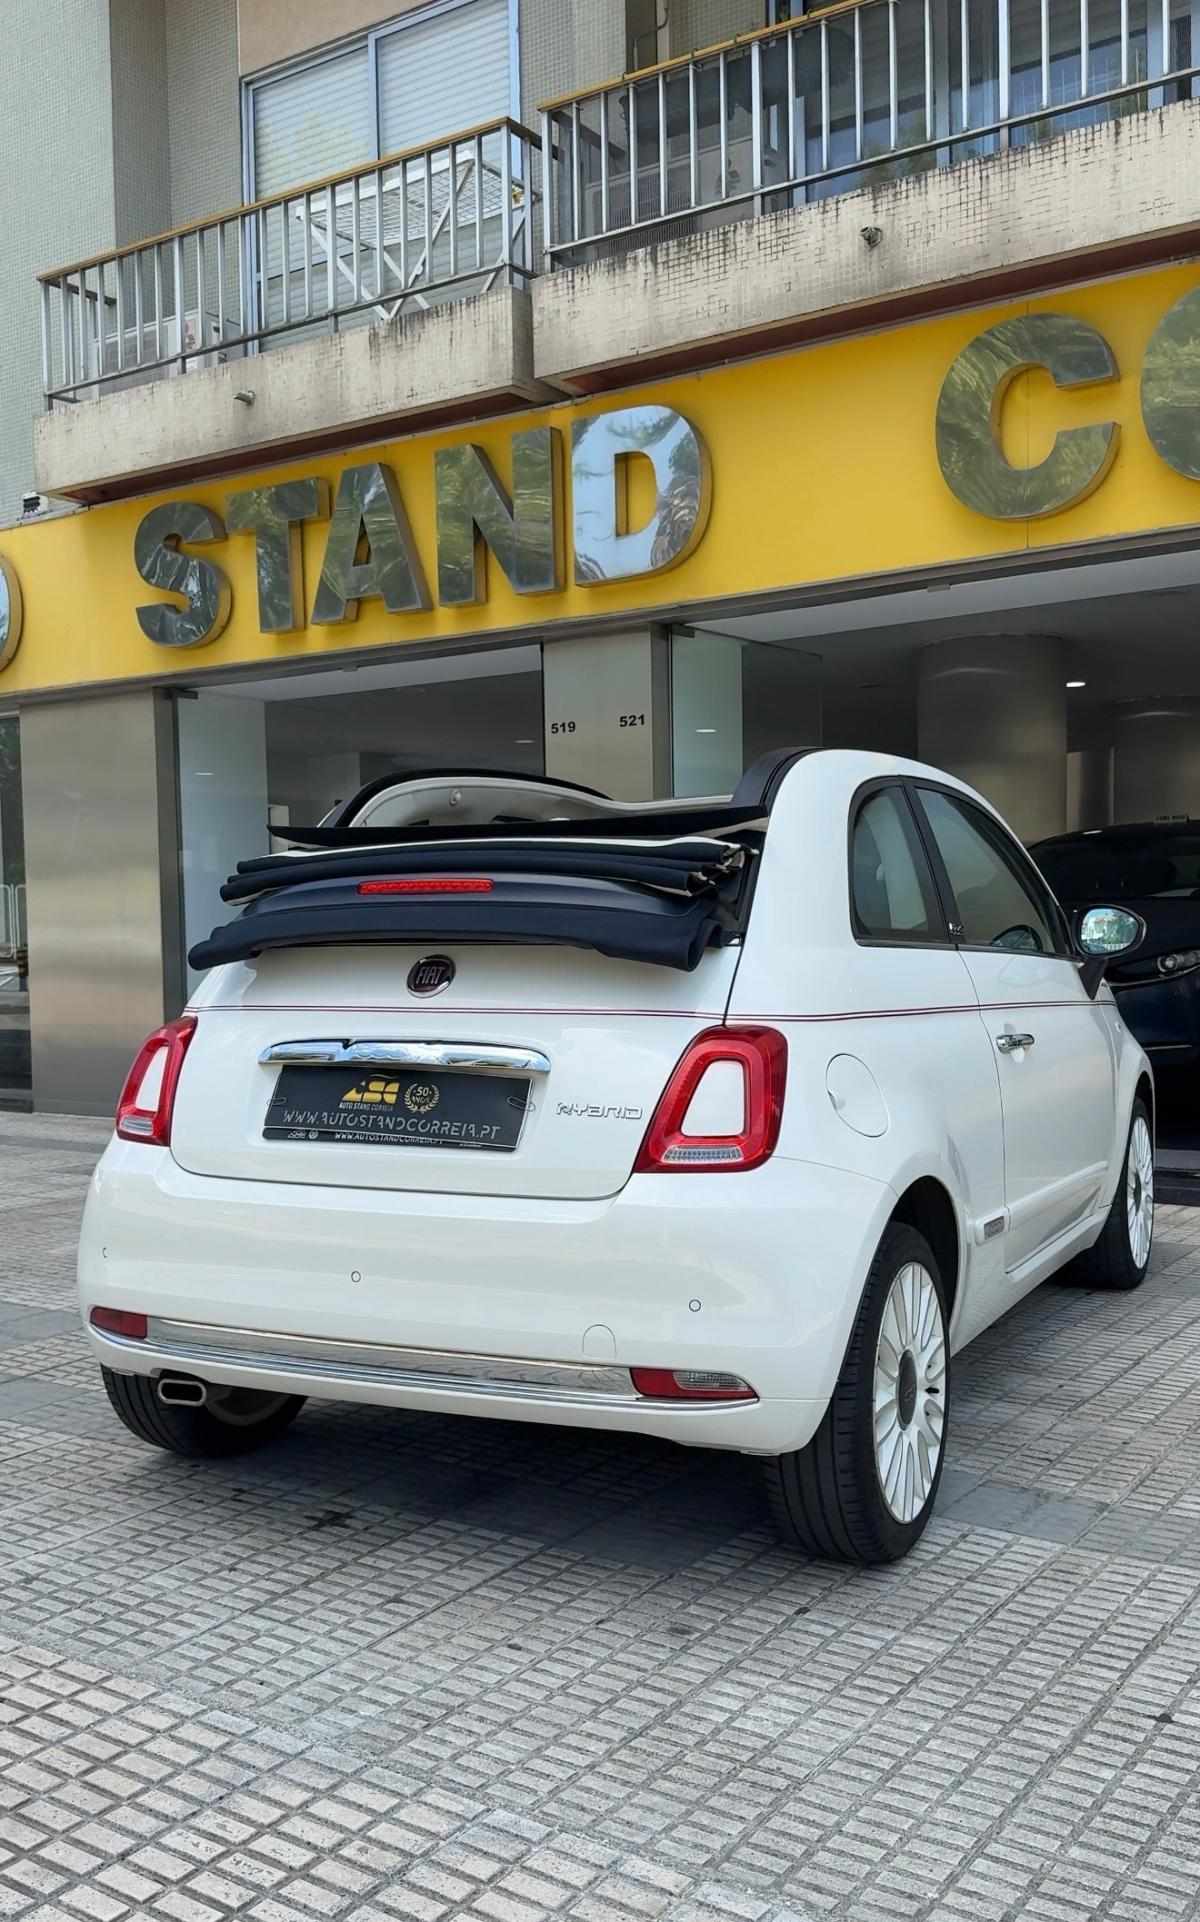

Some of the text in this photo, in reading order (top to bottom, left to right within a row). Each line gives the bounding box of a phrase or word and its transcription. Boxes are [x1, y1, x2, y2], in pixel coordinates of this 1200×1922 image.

[134, 405, 713, 648] STAND
[551, 721, 576, 734] 519
[619, 714, 645, 727] 521
[415, 966, 446, 985] FIAT
[416, 1086, 429, 1097] 50
[556, 1102, 643, 1120] HYBRID
[283, 1109, 502, 1139] WWW.AUTOSTANDCORREIA.PT
